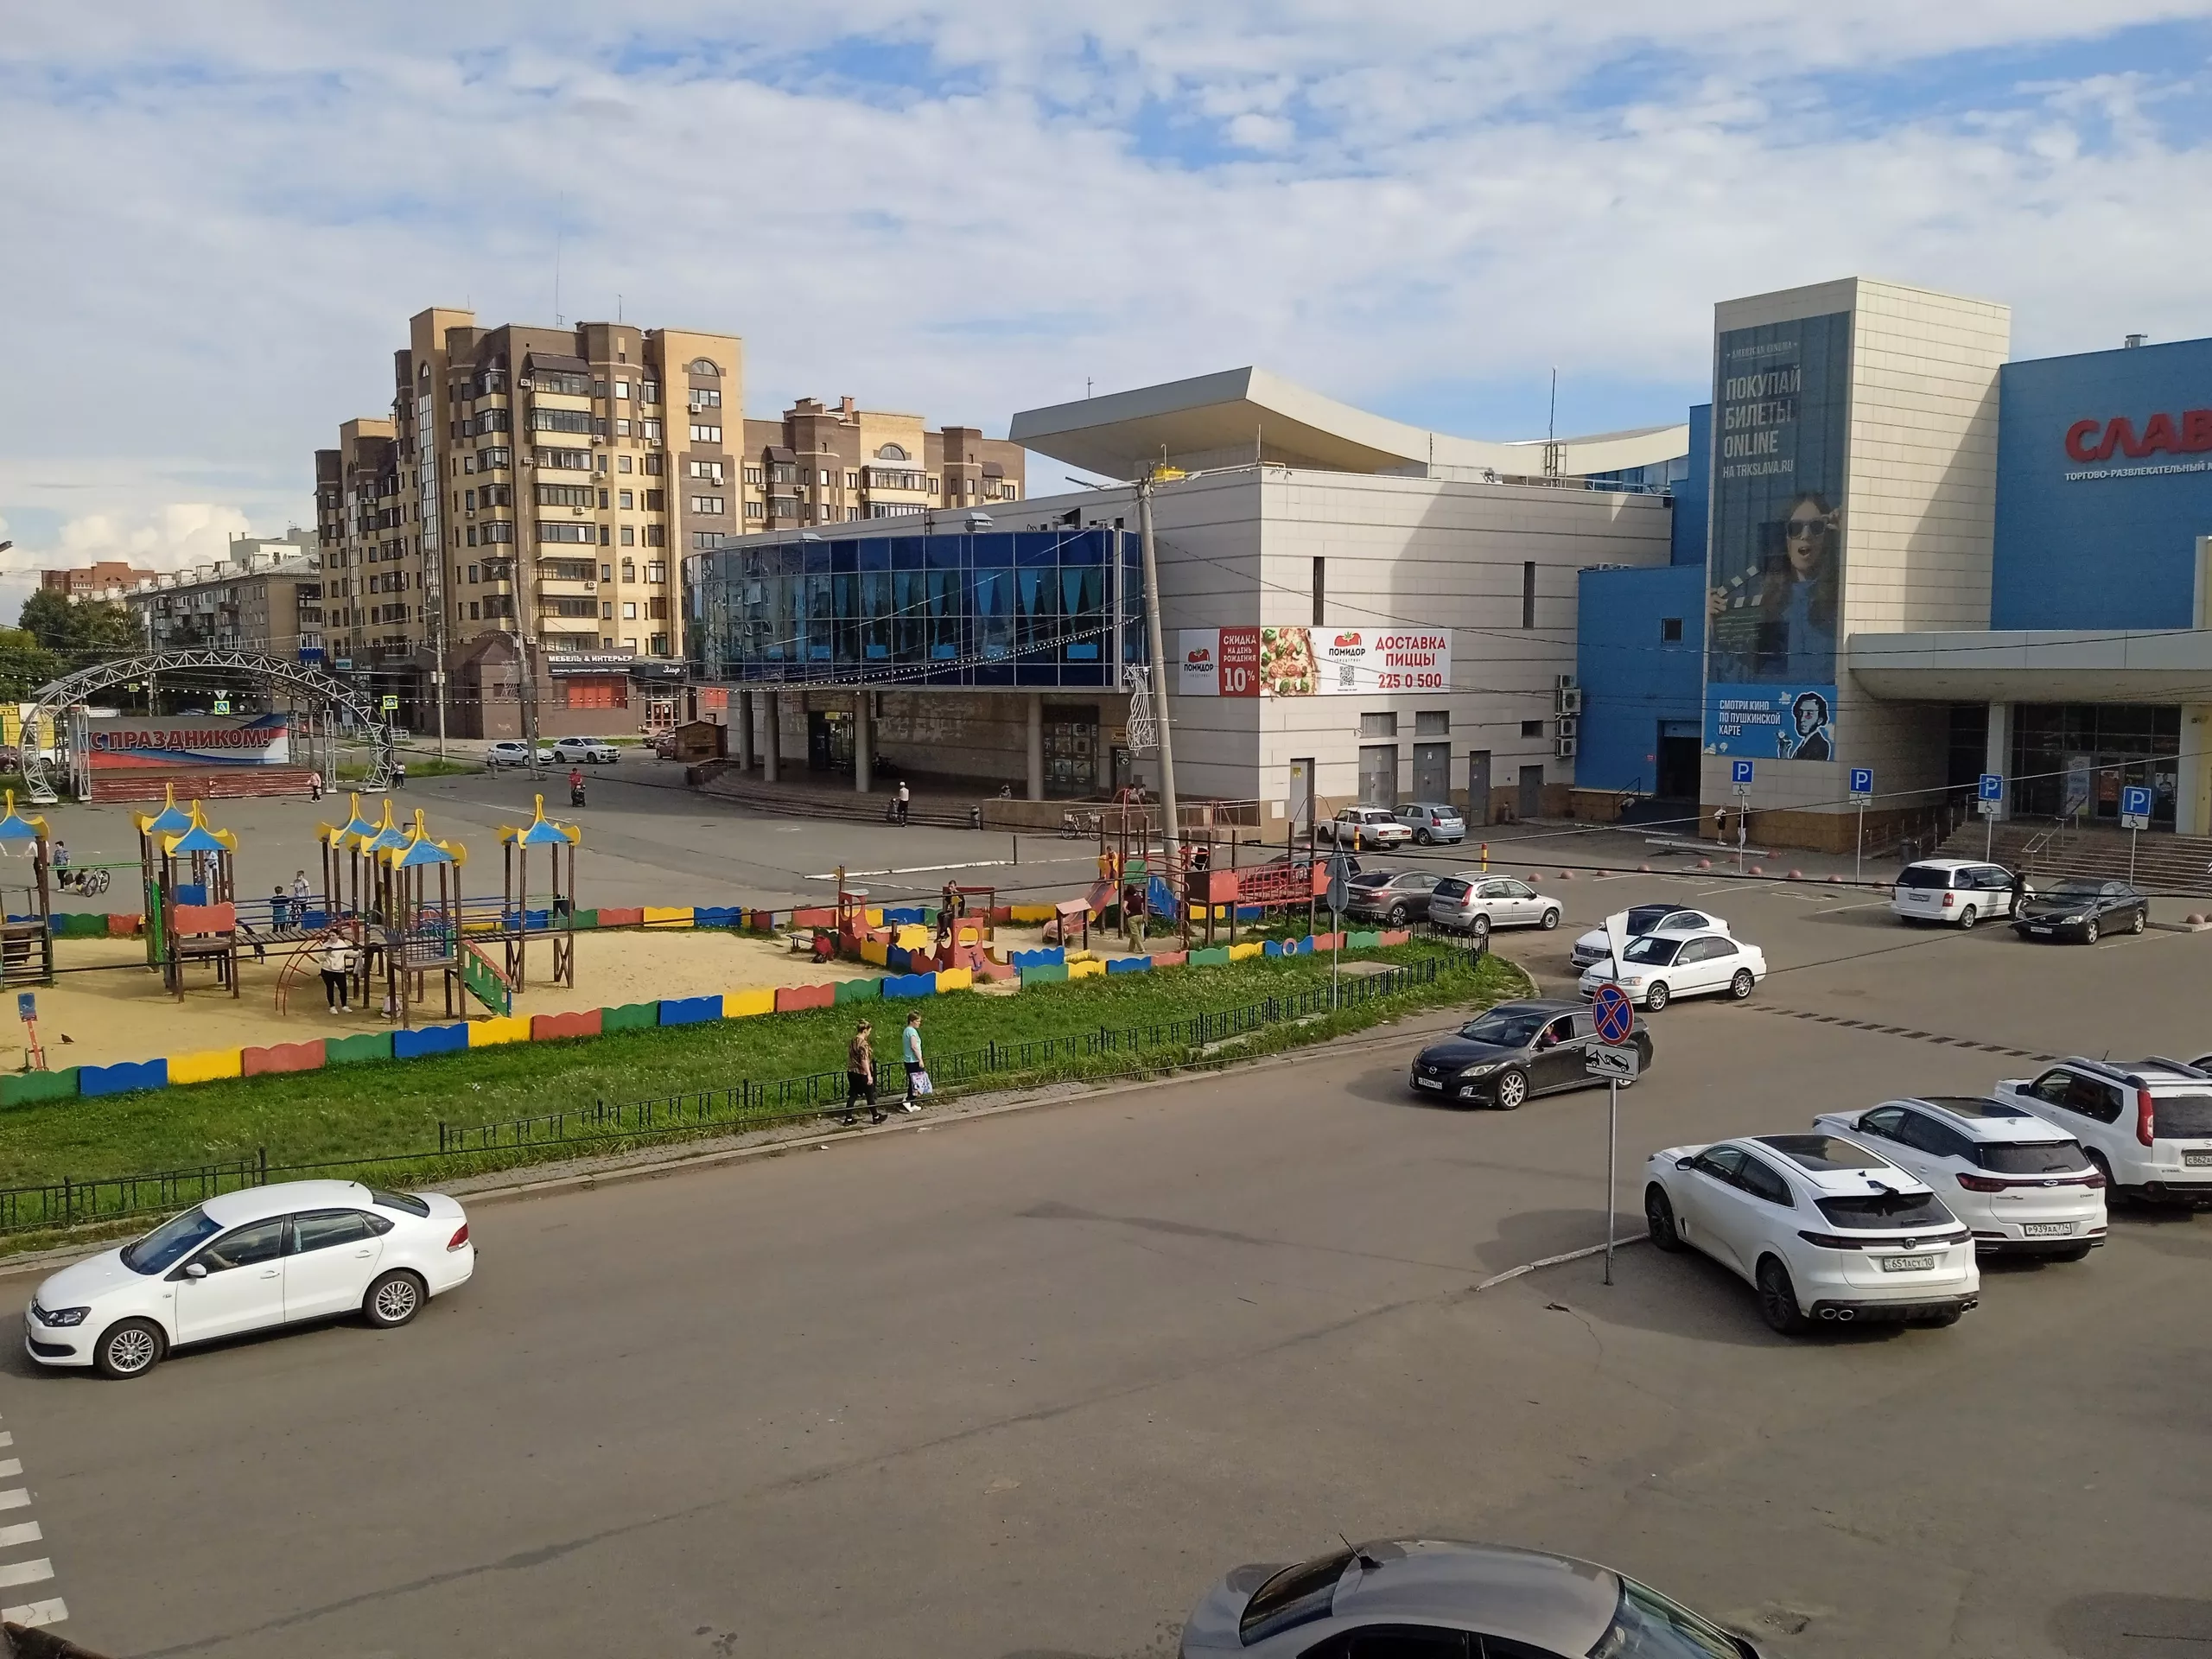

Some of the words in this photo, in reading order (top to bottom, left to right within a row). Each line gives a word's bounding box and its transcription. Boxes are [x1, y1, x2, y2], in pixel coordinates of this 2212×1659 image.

[1726, 365, 1801, 400] ПОКУПАЙ
[1726, 400, 1791, 429] БИЛЕТЫ
[1725, 430, 1779, 458] ONLINE
[1723, 466, 1734, 478] НА
[1737, 459, 1794, 476] TRKSLAVA.RU
[2065, 461, 2204, 480] ТОРГОВО-РАЗВЛЕКАТЕЛЬНЫЙ
[1224, 635, 1256, 645] СКИДКА
[1376, 637, 1446, 651] ДОСТАВКА
[1329, 648, 1366, 657] ПОМИДОР
[1386, 653, 1435, 667] ПИЦЦЫ
[1184, 664, 1214, 672] ПОМИДОР
[1378, 673, 1401, 689] 225
[1405, 674, 1413, 688] 0
[1417, 673, 1442, 688] 500
[1719, 700, 1748, 710] СМОТРИ
[1750, 701, 1770, 710] КИНО
[1719, 712, 1729, 722] ПО
[1731, 712, 1781, 725] ПУШКИНСКОЙ
[1719, 725, 1741, 736] КАРТЕ
[90, 732, 104, 750] С
[108, 728, 271, 752] ПРАЗДНИКОМ!
[1738, 763, 1750, 780] P
[1856, 772, 1868, 789] P
[1986, 778, 1998, 796] P
[2130, 791, 2145, 810] P
